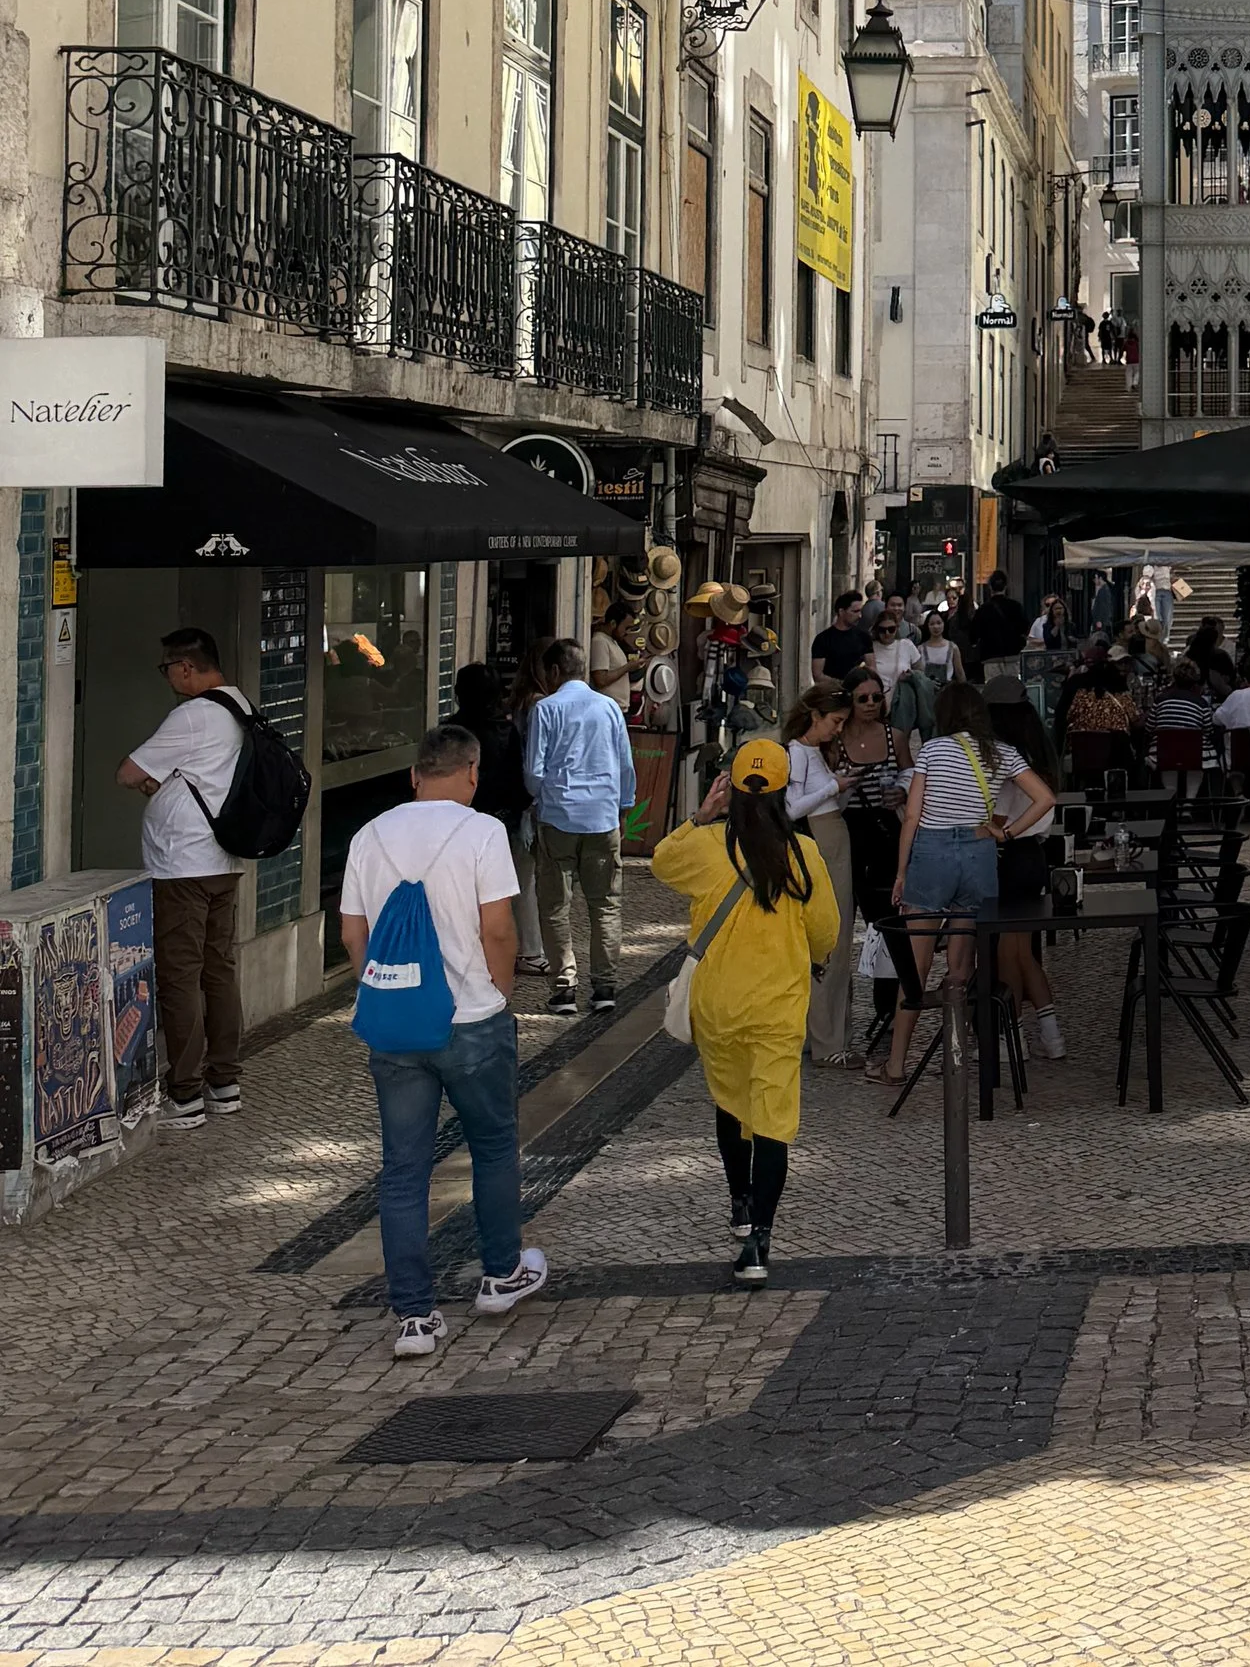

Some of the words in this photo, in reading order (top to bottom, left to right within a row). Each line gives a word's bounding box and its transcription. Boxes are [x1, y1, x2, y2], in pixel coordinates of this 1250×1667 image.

[982, 314, 1014, 325] Normal
[597, 480, 644, 495] iestil
[119, 912, 141, 931] SOCIETY
